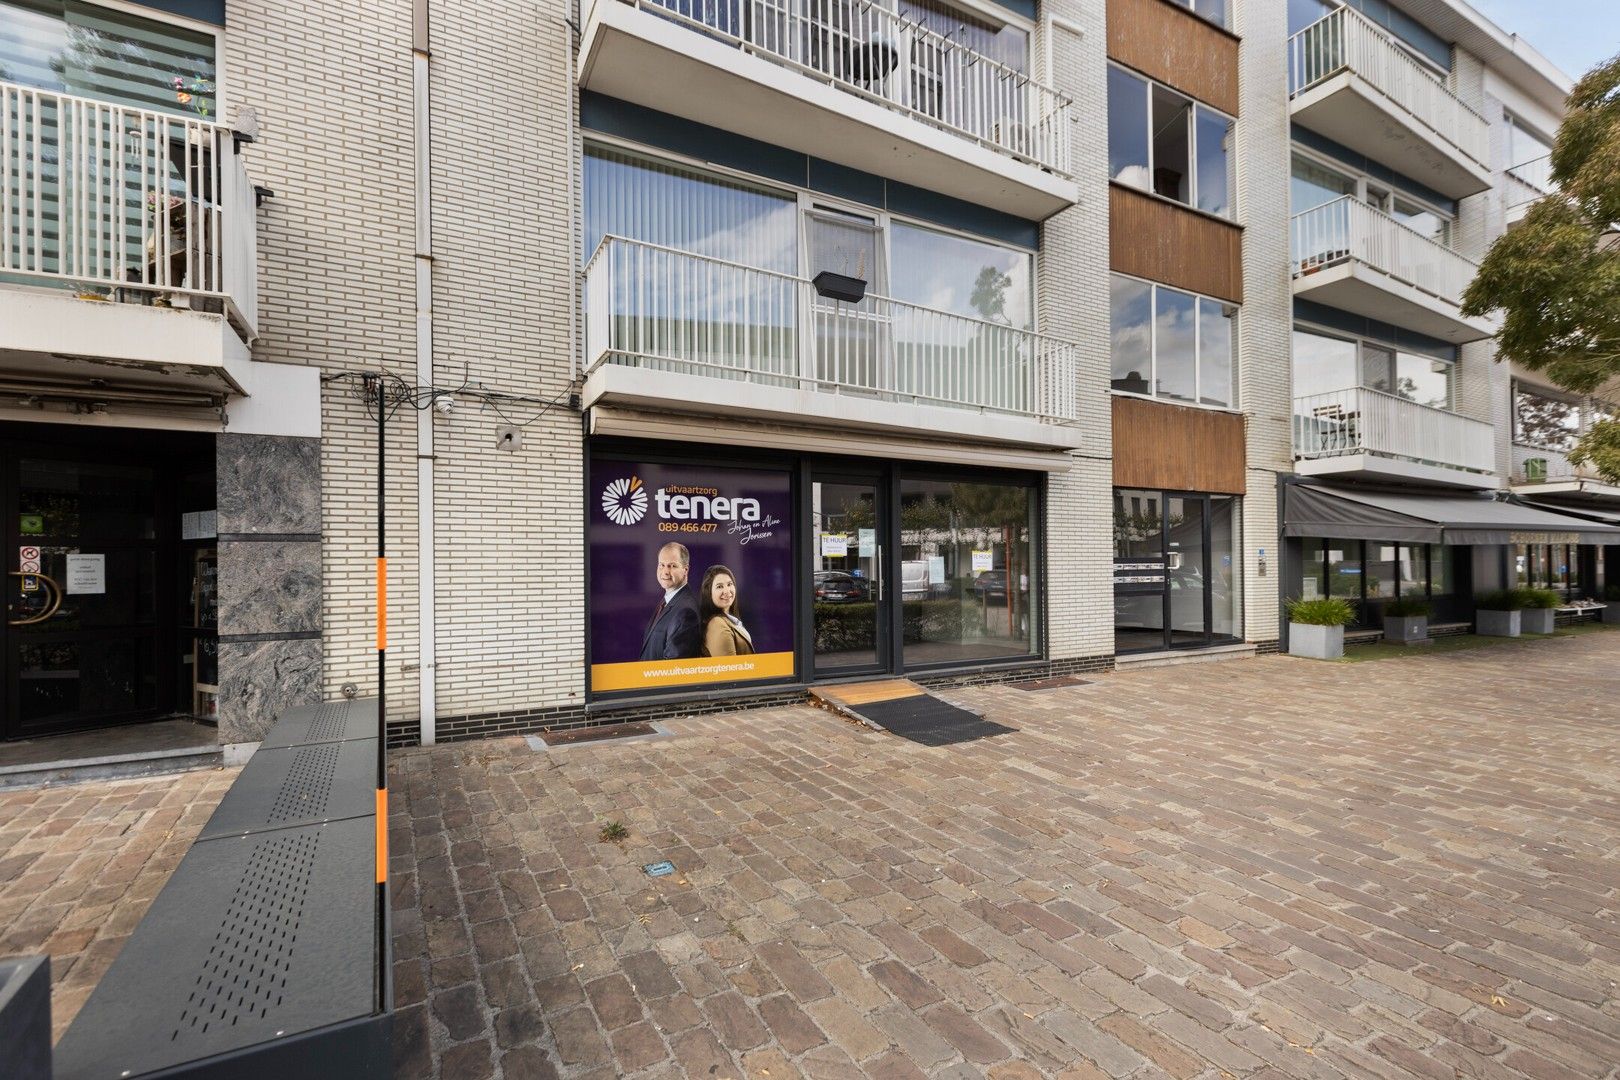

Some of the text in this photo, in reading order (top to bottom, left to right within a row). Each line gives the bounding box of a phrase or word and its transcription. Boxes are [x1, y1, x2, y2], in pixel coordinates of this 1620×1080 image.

[665, 485, 718, 496] uitvaartzorg
[655, 488, 761, 521] tenera
[658, 522, 718, 533] 089 466 477
[643, 661, 755, 678] www.uitvaartzorgtenera.be
